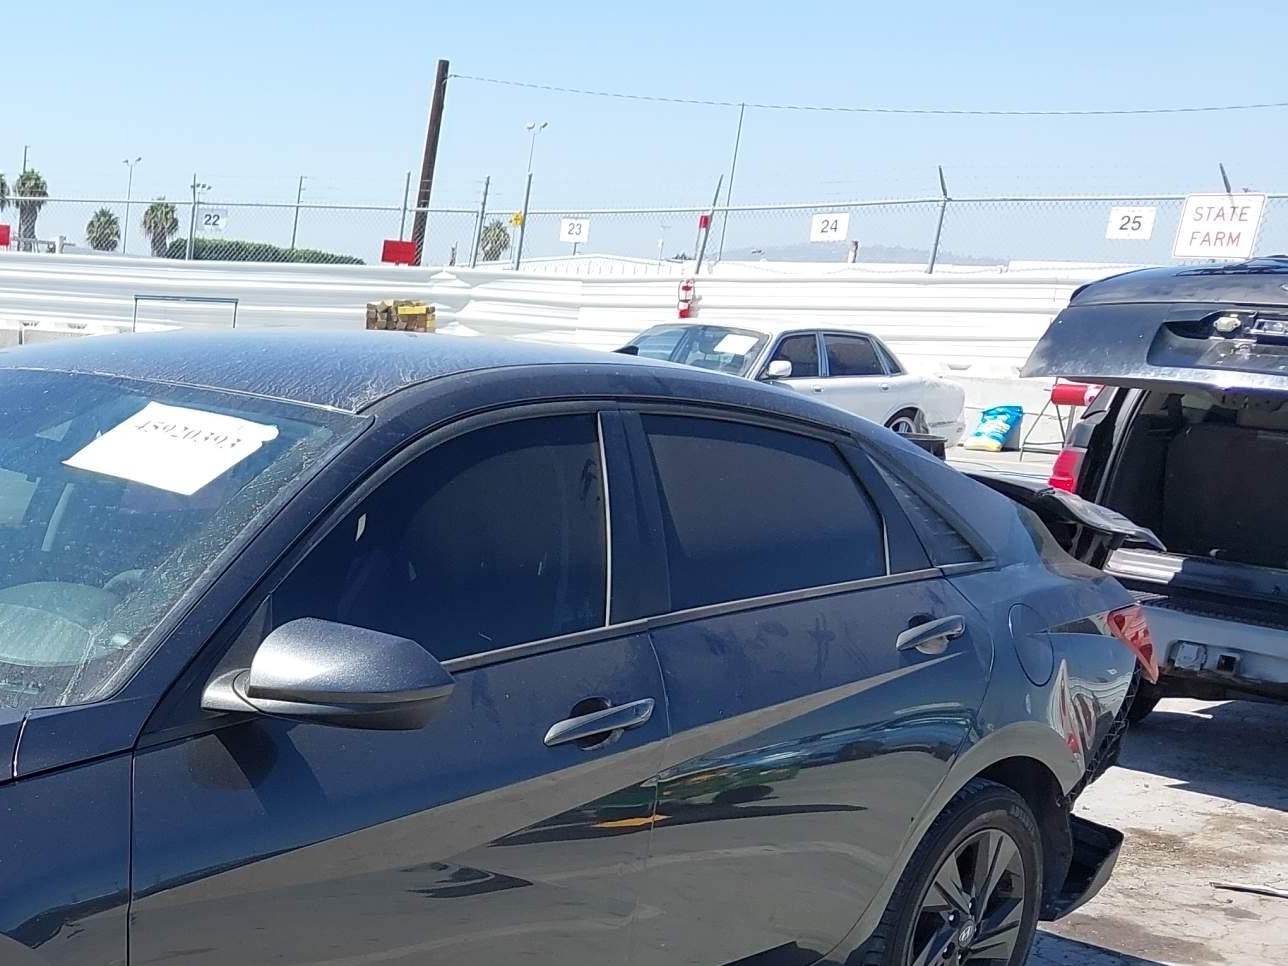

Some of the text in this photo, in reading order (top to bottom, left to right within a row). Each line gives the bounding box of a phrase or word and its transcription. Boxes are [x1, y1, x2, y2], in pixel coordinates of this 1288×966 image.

[204, 213, 220, 226] 22
[1193, 206, 1251, 222] STATE
[567, 222, 582, 236] 23
[820, 218, 838, 233] 24
[1119, 215, 1143, 231] 25
[1189, 231, 1241, 247] FARM
